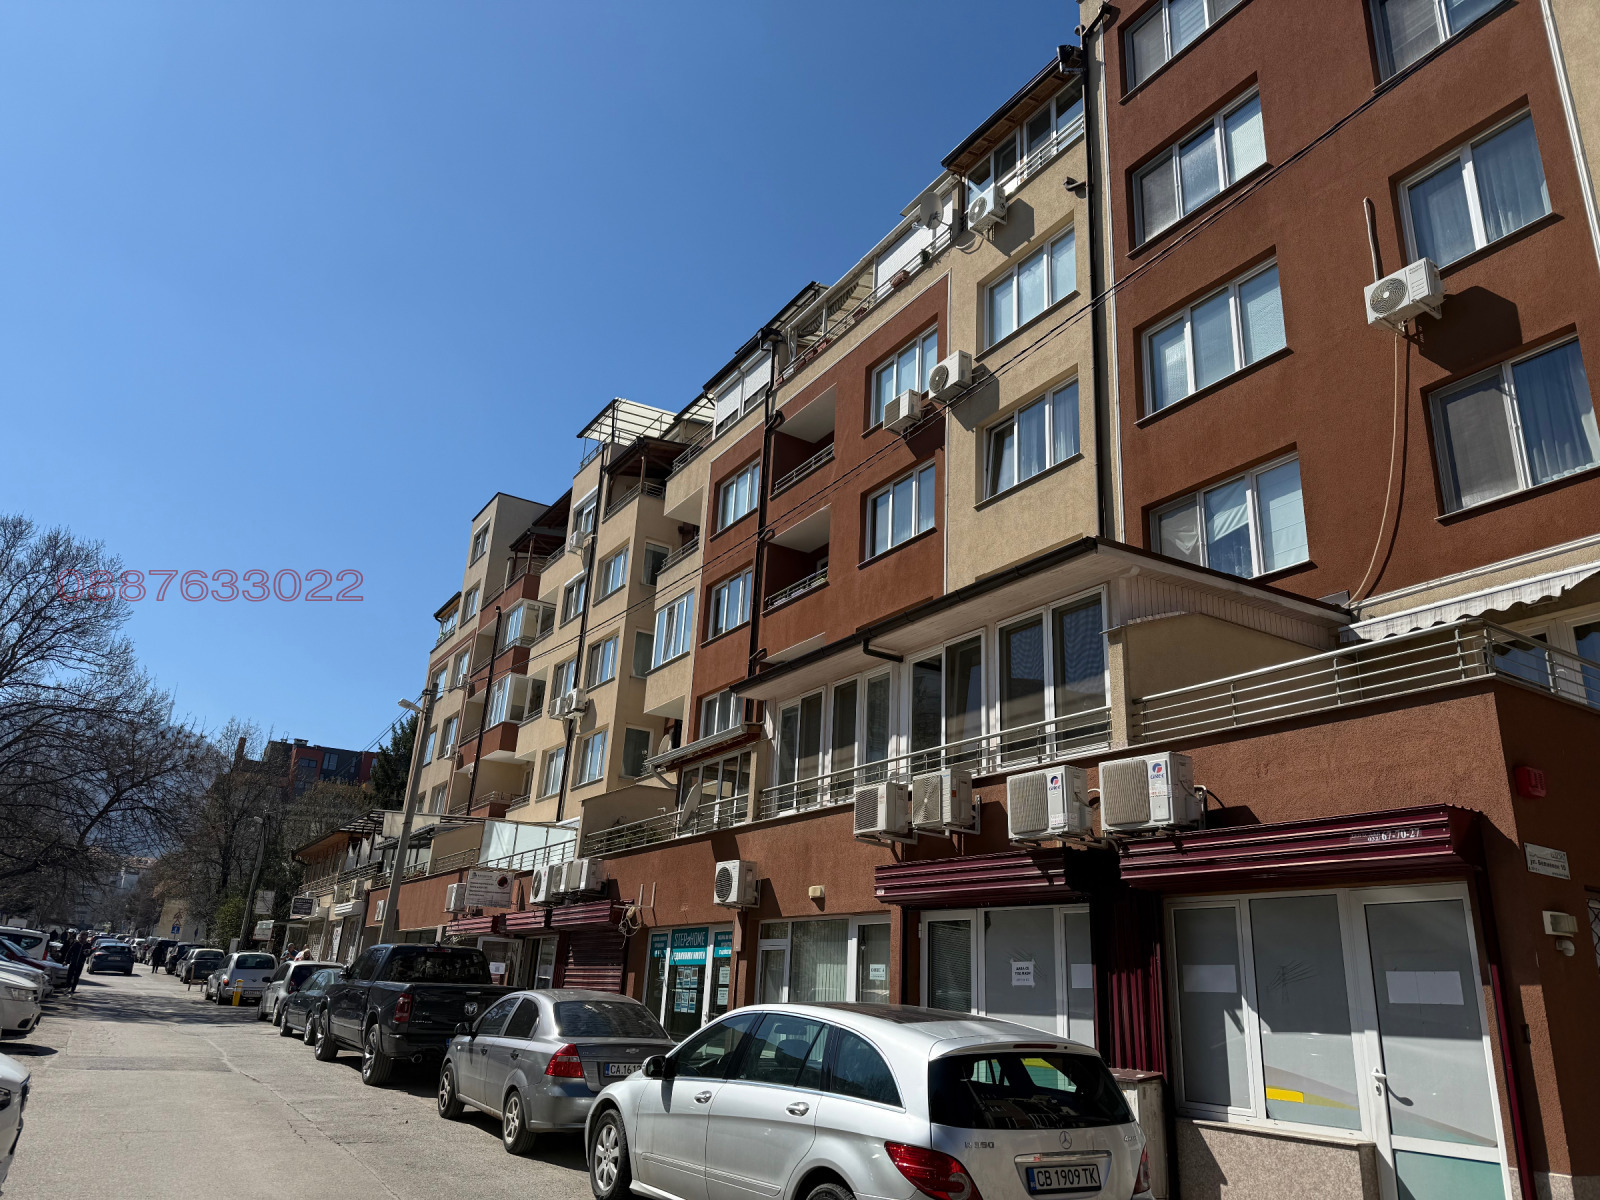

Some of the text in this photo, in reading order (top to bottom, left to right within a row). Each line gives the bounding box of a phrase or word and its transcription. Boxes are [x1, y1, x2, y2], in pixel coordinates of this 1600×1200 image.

[1037, 1170, 1053, 1187] CB
[1055, 1168, 1081, 1186] 1909
[1082, 1167, 1098, 1185] TK
